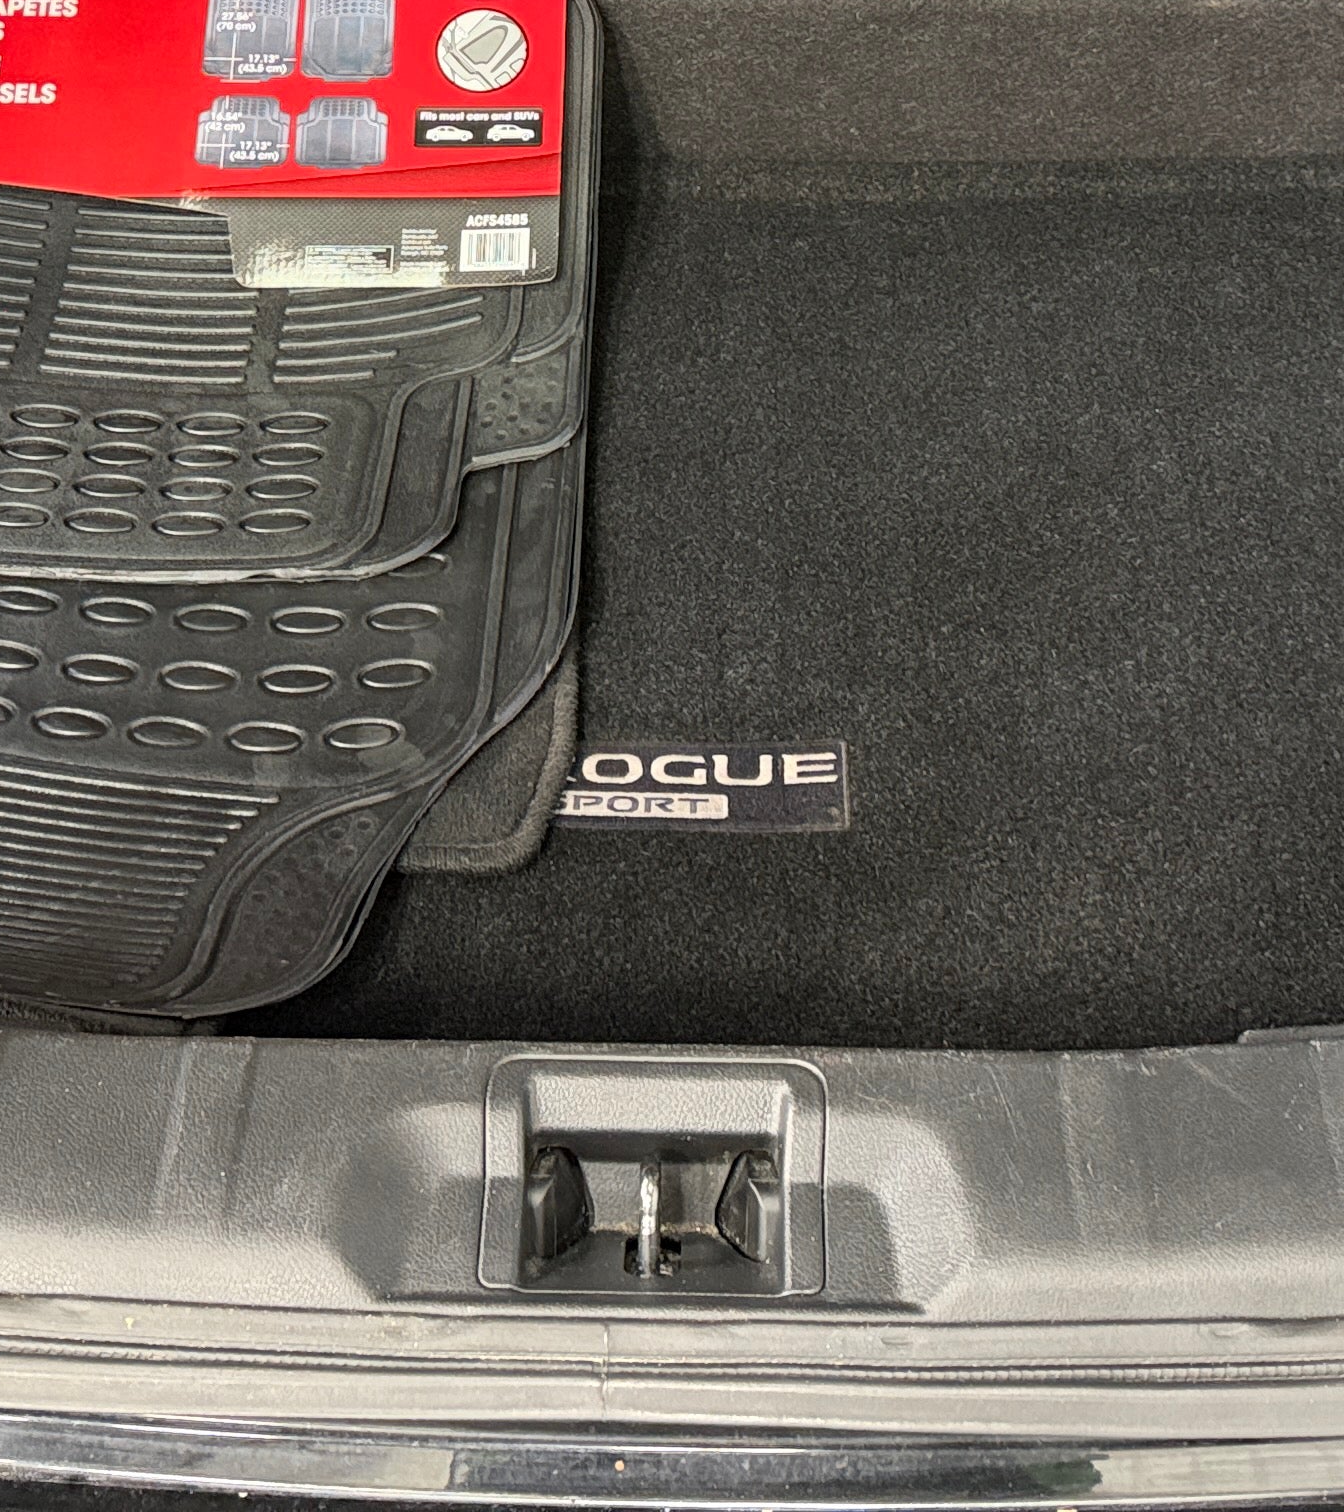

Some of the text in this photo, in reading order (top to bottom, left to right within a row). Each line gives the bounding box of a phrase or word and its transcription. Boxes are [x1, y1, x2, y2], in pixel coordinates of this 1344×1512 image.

[235, 21, 257, 33] cm)
[265, 64, 287, 75] cm)
[419, 111, 540, 121] Fits most cars and SUVs
[224, 121, 246, 133] cm)
[257, 150, 280, 163] cm)
[566, 752, 838, 787] OGUE
